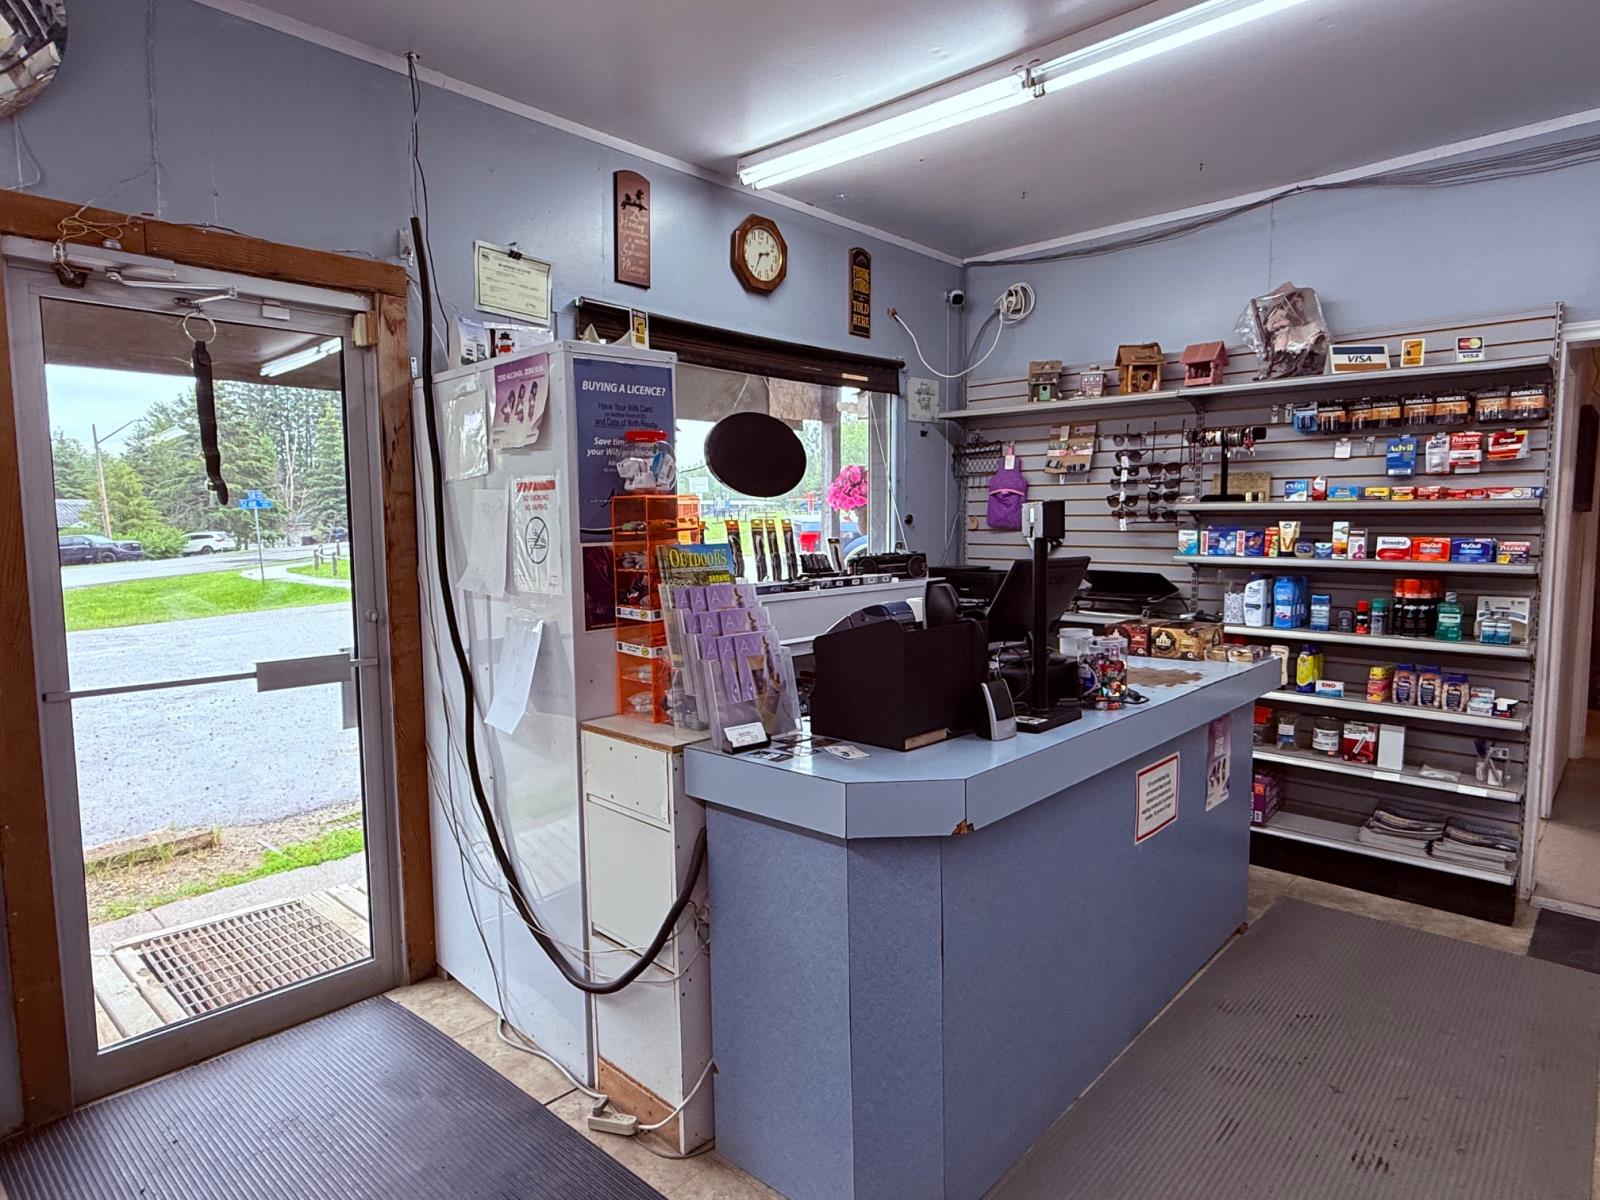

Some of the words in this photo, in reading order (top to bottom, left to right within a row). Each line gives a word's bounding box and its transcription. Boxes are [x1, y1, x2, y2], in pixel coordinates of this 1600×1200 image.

[852, 300, 870, 315] TOLD
[852, 314, 870, 329] HERE
[1347, 355, 1372, 363] VISA
[582, 380, 617, 393] BUYING
[618, 384, 626, 394] A
[627, 385, 666, 396] LICENCE?
[598, 402, 613, 410] Have
[640, 405, 653, 413] Card
[595, 418, 606, 426] and
[594, 436, 612, 446] Save
[612, 438, 625, 446] tim
[1452, 435, 1480, 443] TYLENOL
[586, 448, 605, 457] your
[1390, 444, 1414, 452] Advil
[669, 548, 728, 568] OUTDOORS
